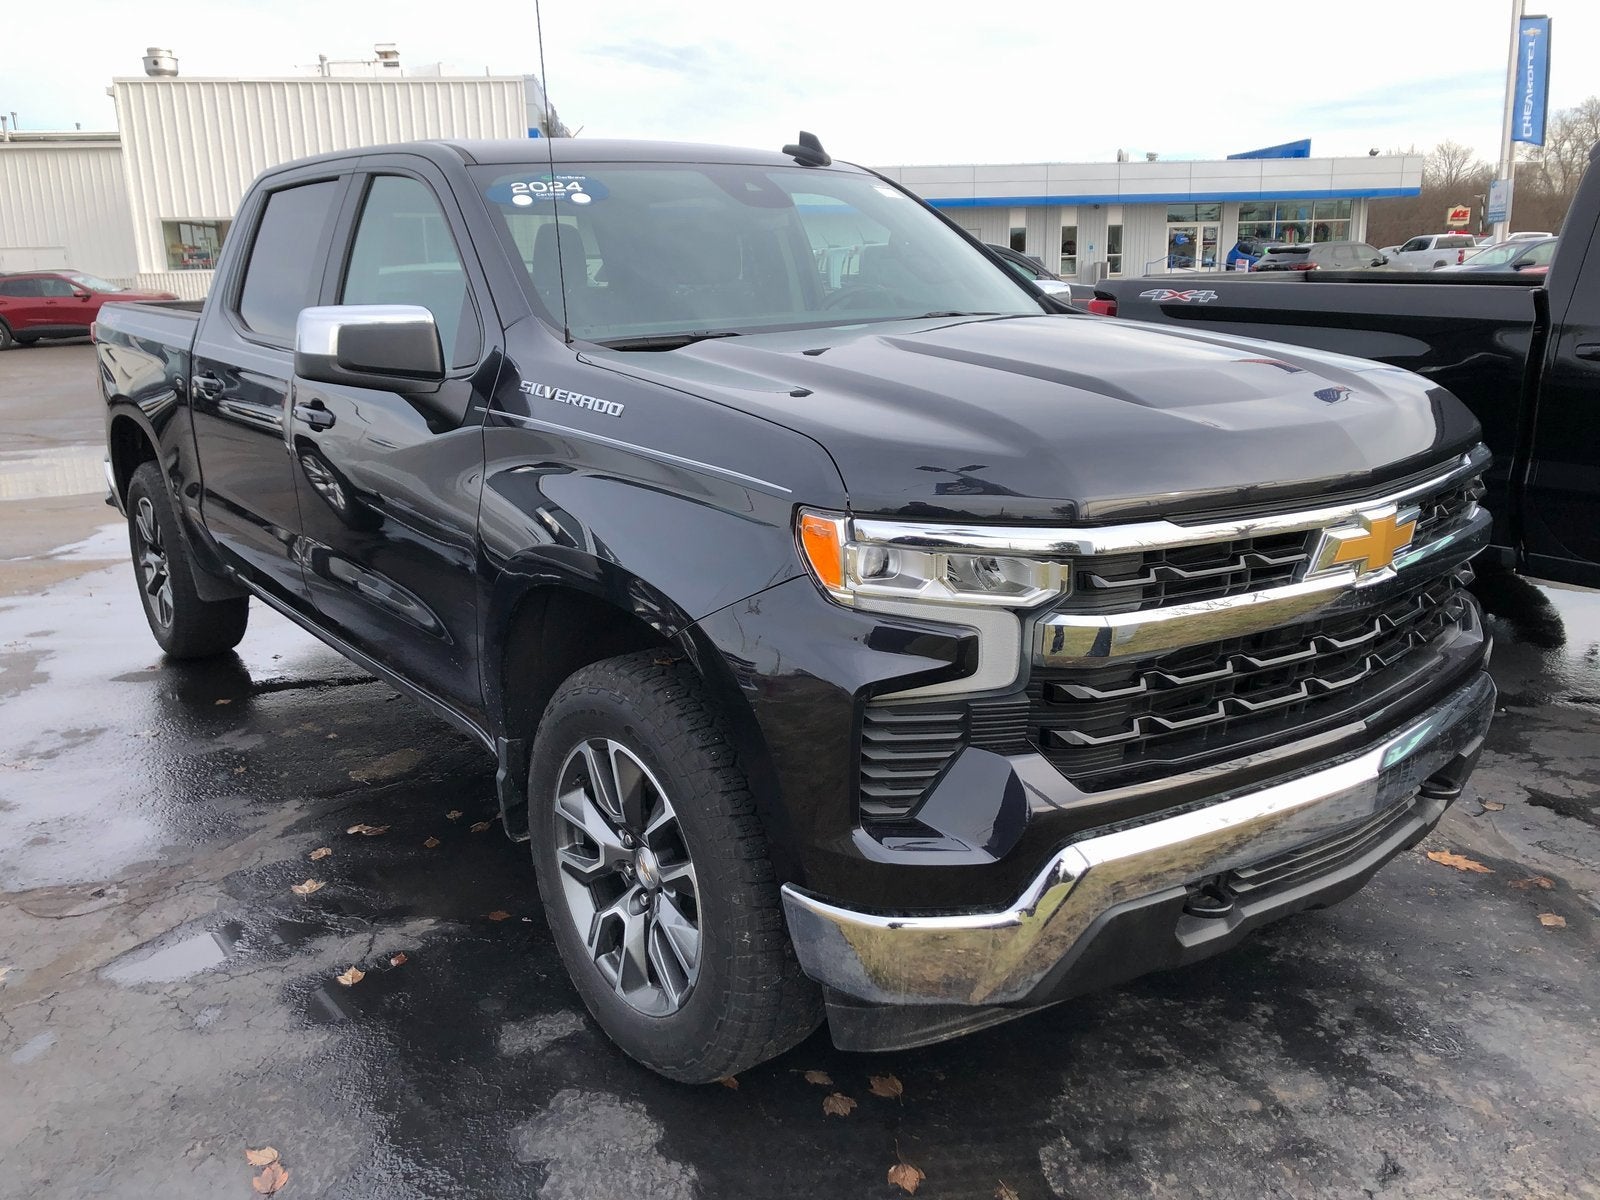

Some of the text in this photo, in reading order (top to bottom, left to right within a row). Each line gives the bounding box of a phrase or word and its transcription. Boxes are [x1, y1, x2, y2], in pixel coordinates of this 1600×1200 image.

[511, 181, 583, 194] 2024
[1450, 209, 1469, 218] ACE
[519, 380, 624, 417] SILVERADO
